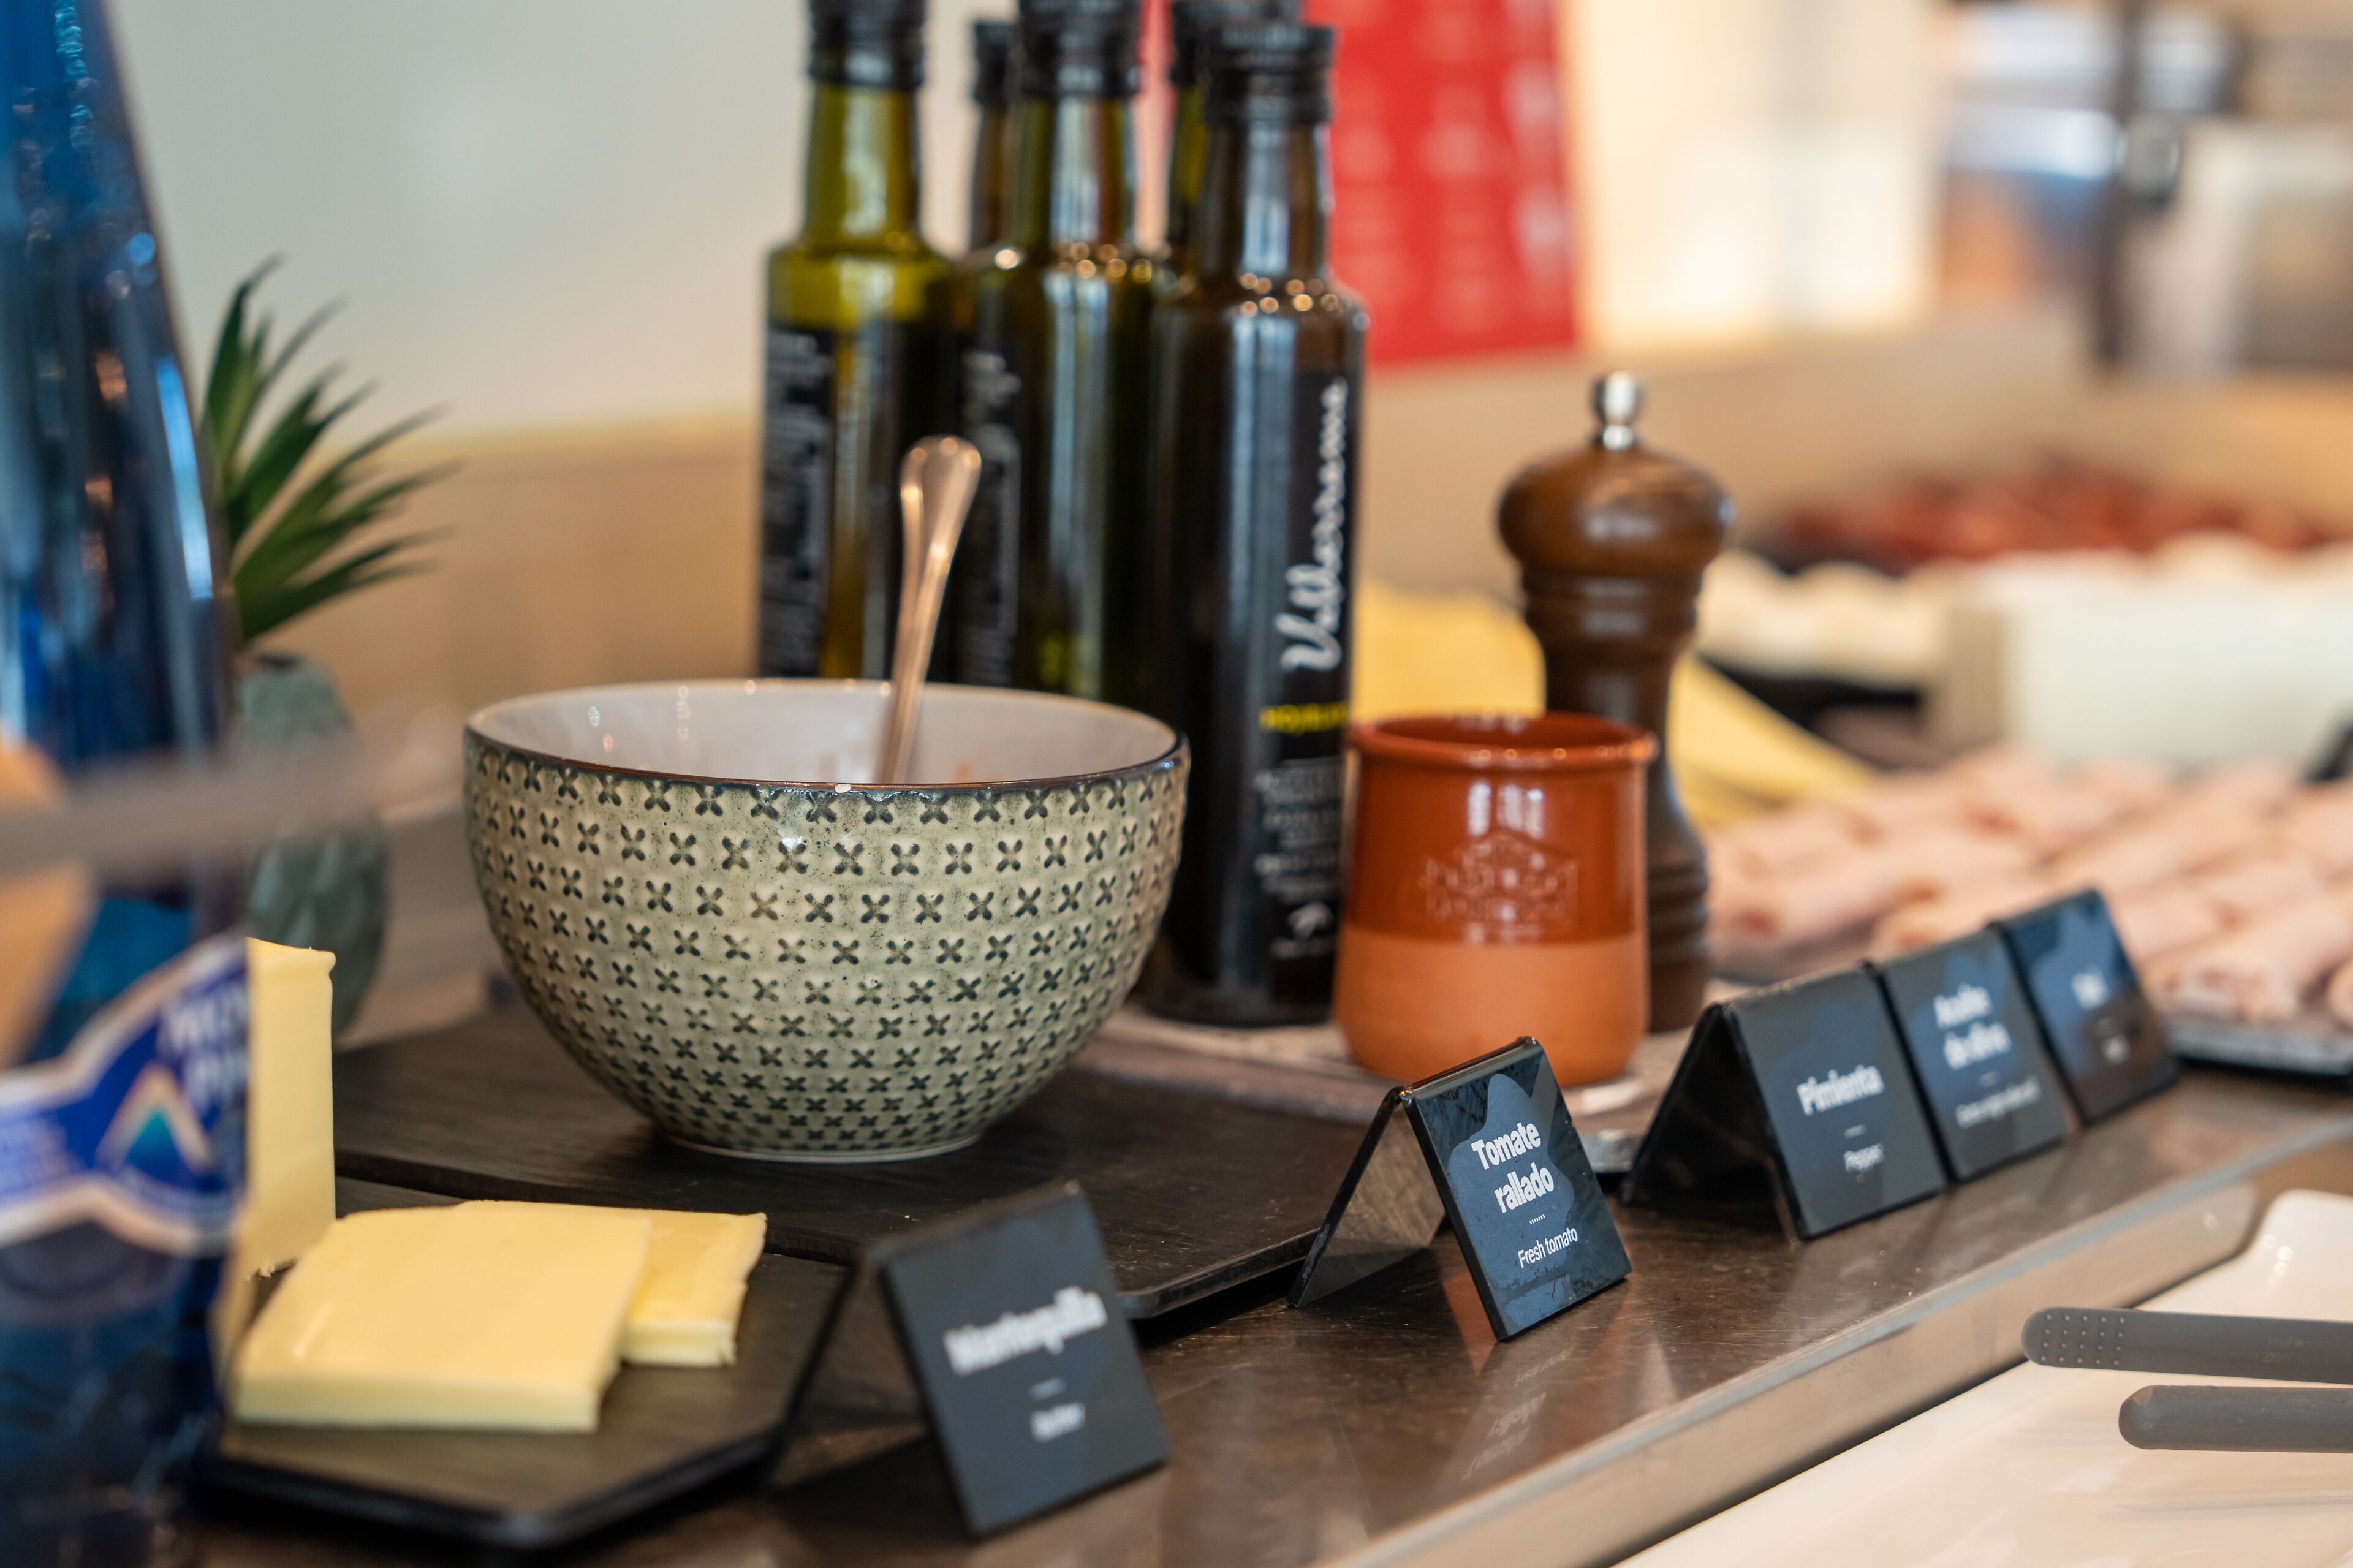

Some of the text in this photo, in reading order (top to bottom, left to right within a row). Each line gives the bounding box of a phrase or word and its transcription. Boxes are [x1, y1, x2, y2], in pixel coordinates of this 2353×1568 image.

[1471, 1122, 1541, 1170] Tomate
[1494, 1162, 1554, 1213] rallado
[1518, 1227, 1578, 1268] Fresh tomato
